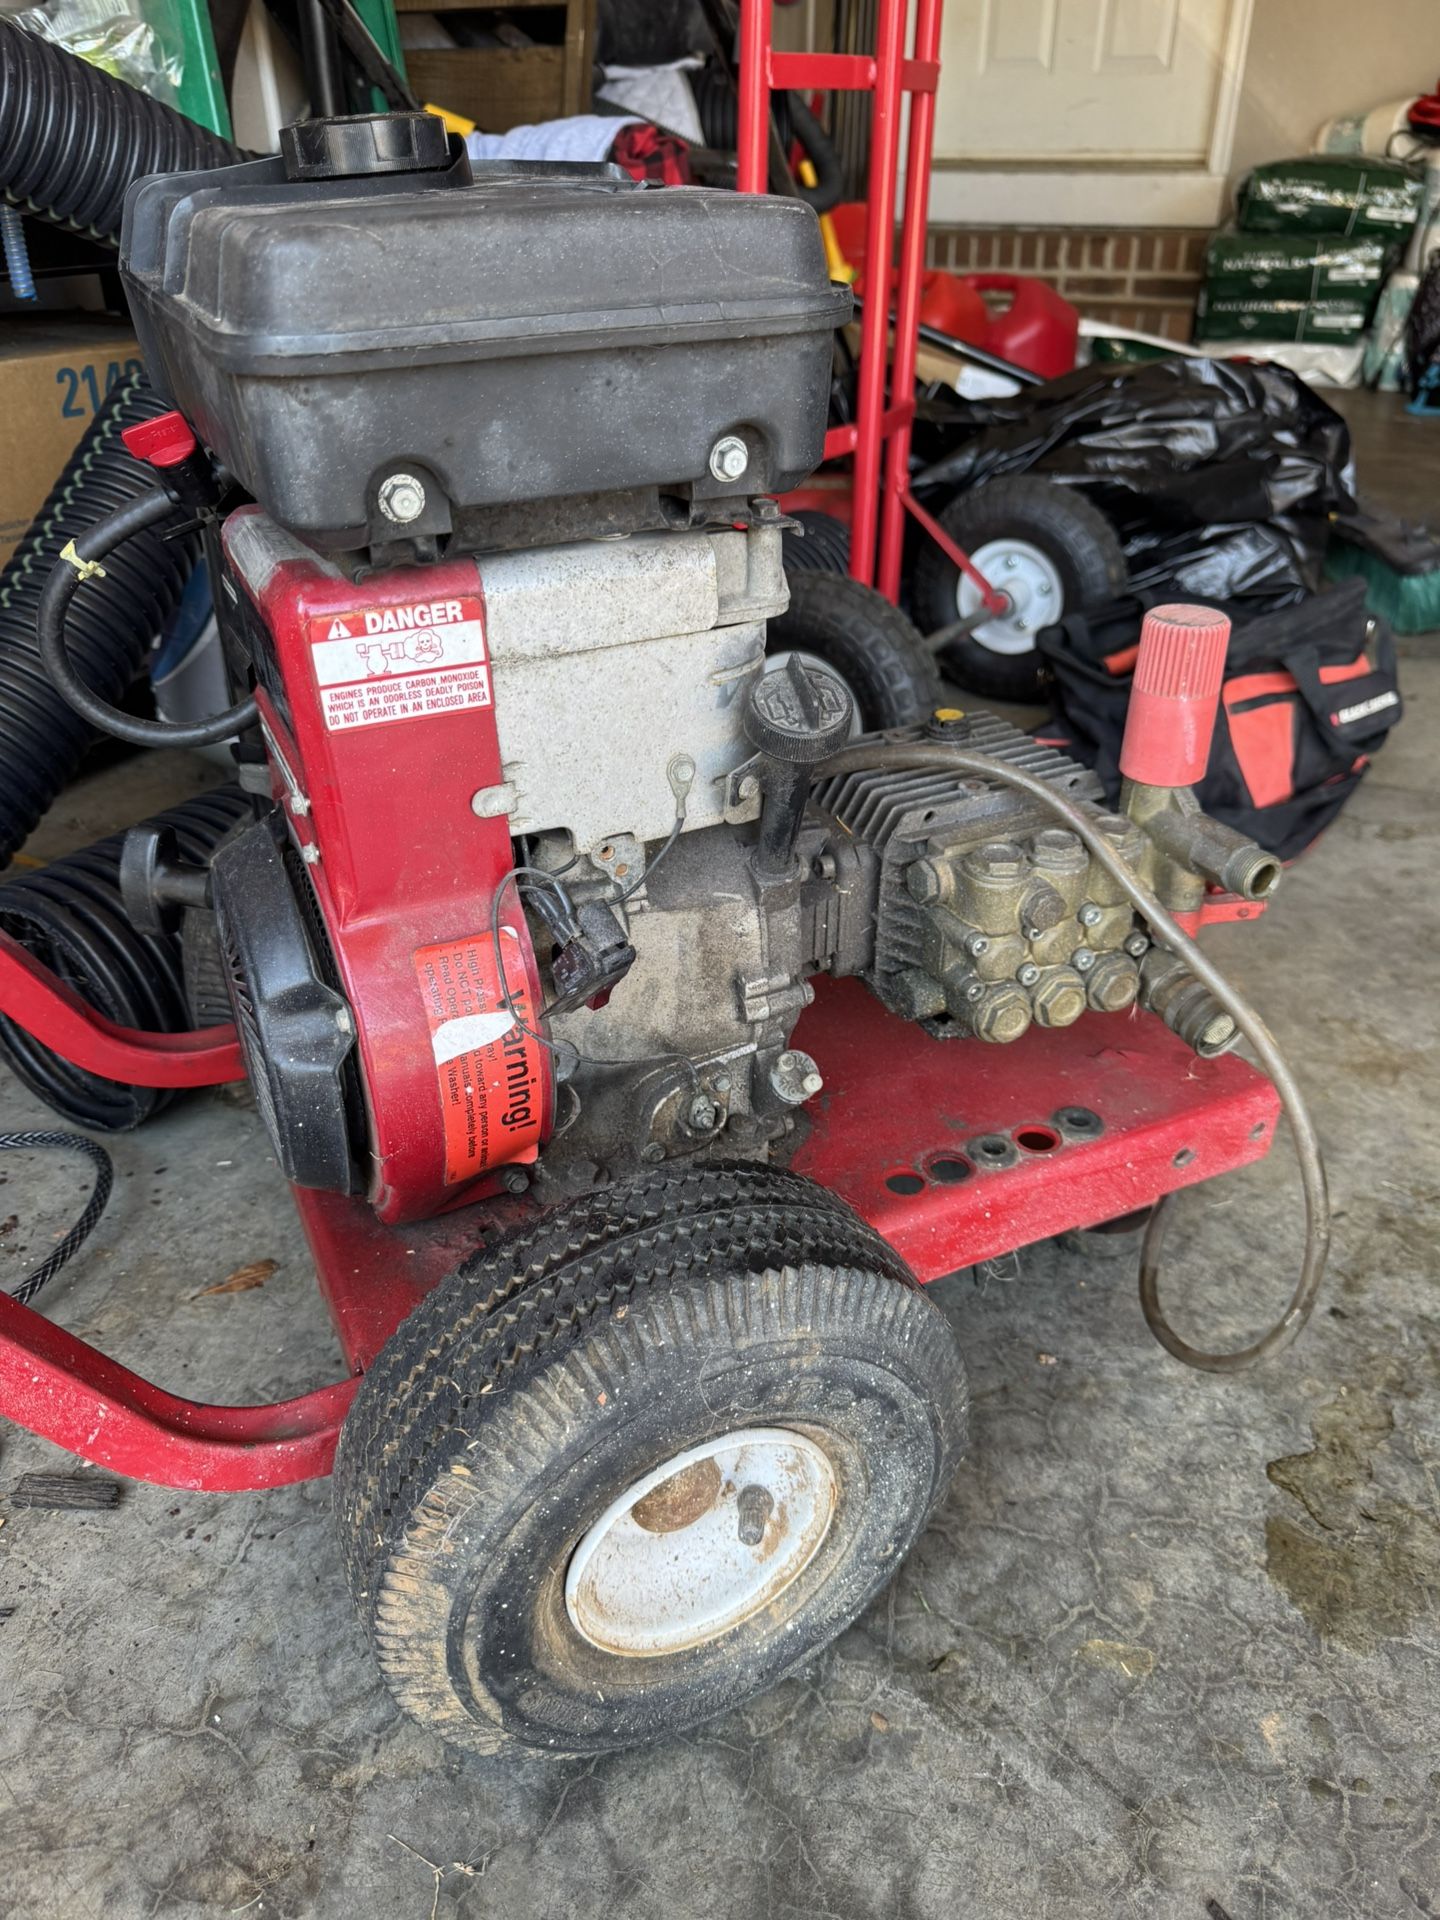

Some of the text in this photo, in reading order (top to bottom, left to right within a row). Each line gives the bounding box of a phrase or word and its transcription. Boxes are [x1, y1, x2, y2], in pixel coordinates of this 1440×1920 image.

[365, 601, 464, 634] DANGER
[328, 680, 484, 713] WHICH IS AN ODORLESS DEADLY POISON
[329, 670, 480, 702] ENGINES PRODUCE CARBON MONOXIDE
[329, 692, 488, 726] DO NOT OPERATE IN AN ENCLOSED AREA
[453, 952, 463, 968] Do
[467, 949, 480, 976] High
[424, 963, 444, 1015] operating
[447, 1067, 461, 1106] Washer!
[439, 955, 453, 984] Read
[460, 1053, 474, 1088] anuals
[467, 1136, 477, 1158] before
[474, 1060, 487, 1094] toward
[477, 1094, 487, 1109] any
[479, 1111, 489, 1138] person
